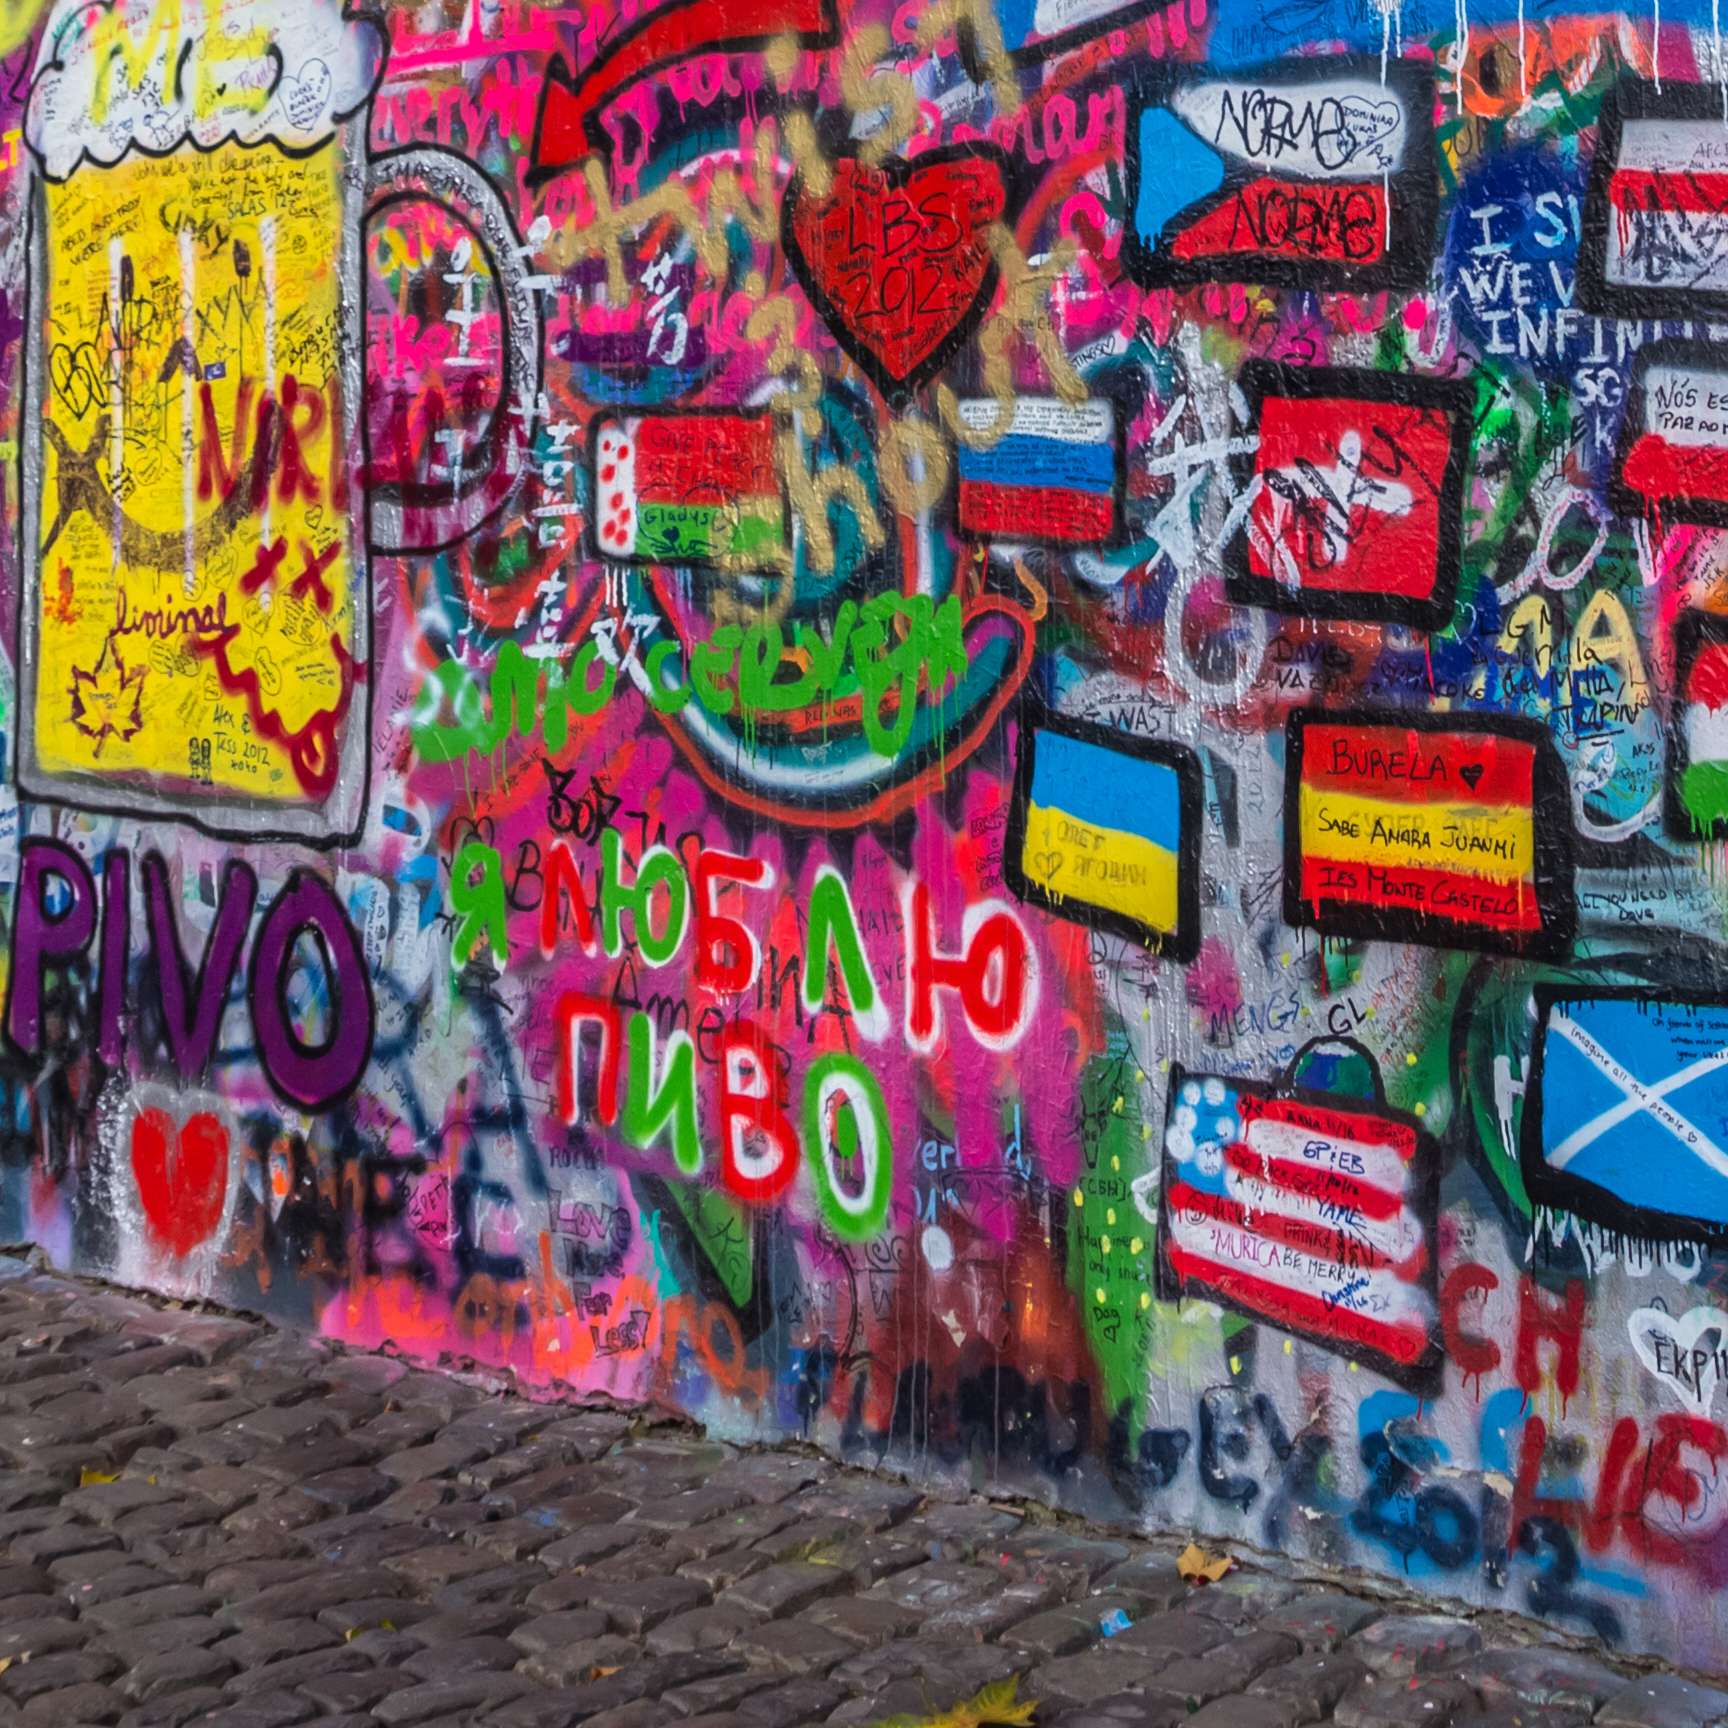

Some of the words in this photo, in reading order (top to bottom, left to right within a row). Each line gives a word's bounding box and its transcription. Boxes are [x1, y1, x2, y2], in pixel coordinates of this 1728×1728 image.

[848, 187, 965, 258] LBS
[844, 263, 951, 321] 2012
[1658, 412, 1693, 431] PAZ
[242, 738, 270, 767] 2012
[1327, 738, 1448, 782] BURELA
[1317, 807, 1360, 840] SABE
[1370, 817, 1432, 851] AMARA
[1367, 870, 1427, 903] MONTE
[1430, 880, 1519, 916] CASTELO
[449, 841, 509, 975] Я
[540, 827, 1042, 1056] ЛЮБЛЮ
[2, 834, 375, 1116] PIVO
[1612, 1067, 1628, 1084] all
[552, 990, 893, 1242] ПИВО
[1281, 1250, 1303, 1269] BE
[1306, 1258, 1358, 1284] MERRY
